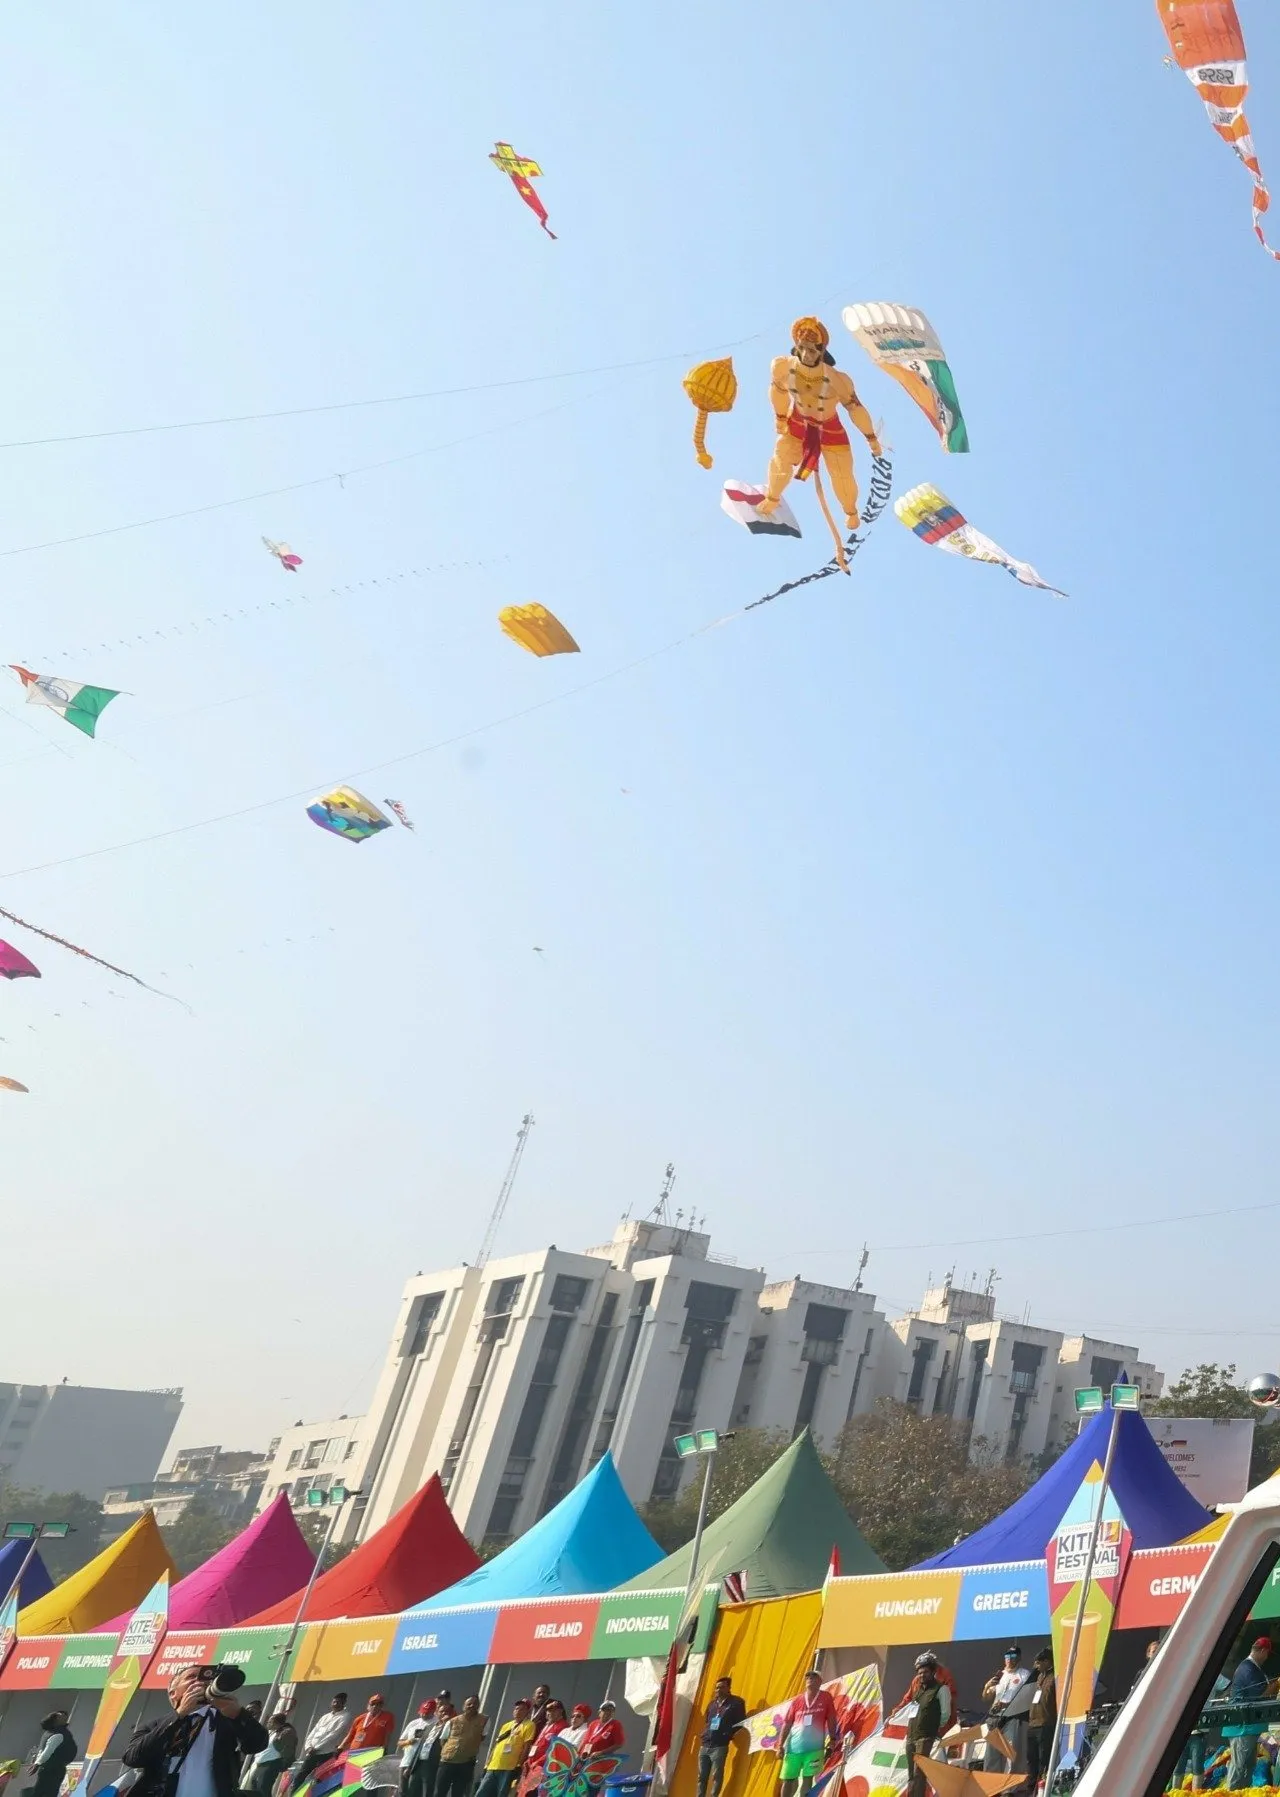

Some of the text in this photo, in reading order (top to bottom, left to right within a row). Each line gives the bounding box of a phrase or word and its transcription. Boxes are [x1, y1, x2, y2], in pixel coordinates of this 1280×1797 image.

[1057, 1549, 1118, 1570] FESTVAL
[1149, 1574, 1200, 1596] GERM
[874, 1597, 943, 1618] HUNGARY
[973, 1590, 1029, 1612] GREECE
[128, 1619, 152, 1634] KITE
[534, 1622, 583, 1639] IRELAND
[605, 1615, 669, 1634] INDONESIA
[123, 1634, 157, 1646] FESTIVAL
[351, 1639, 382, 1656] ITALY
[401, 1634, 438, 1651] ISRAEL
[162, 1645, 206, 1659] REPUBLIC
[220, 1650, 252, 1664] JAPAN
[16, 1657, 50, 1670] POLAND
[63, 1655, 113, 1668] PHILIPPINES
[156, 1662, 172, 1675] OF
